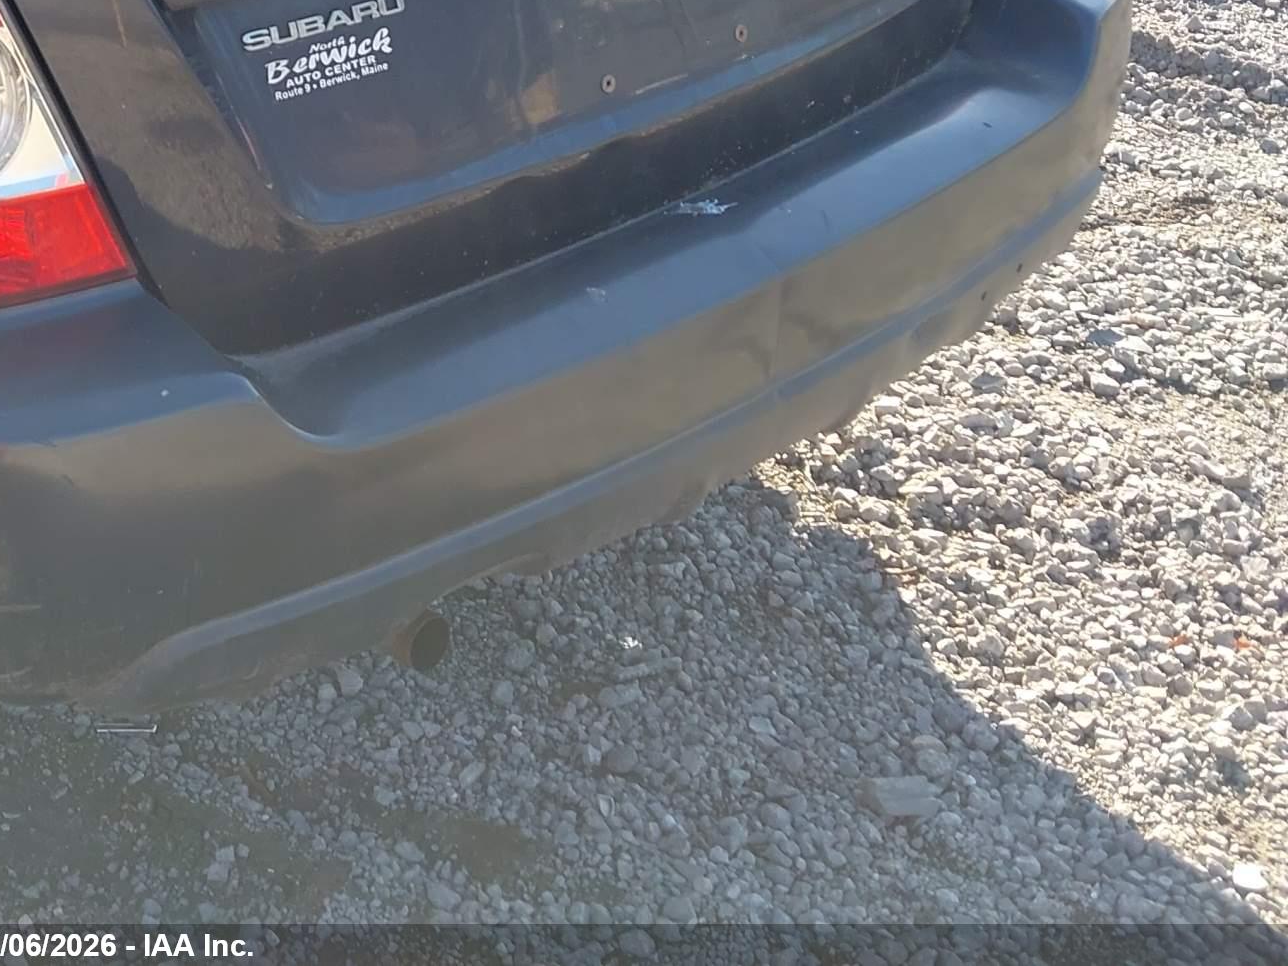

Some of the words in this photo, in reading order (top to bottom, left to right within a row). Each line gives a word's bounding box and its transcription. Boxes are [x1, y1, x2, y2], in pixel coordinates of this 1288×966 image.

[264, 27, 393, 85] Berwick
[309, 36, 346, 53] North
[275, 85, 304, 101] Route
[361, 62, 389, 76] Maine
[286, 70, 322, 88] AUTO
[325, 55, 377, 76] CENTER
